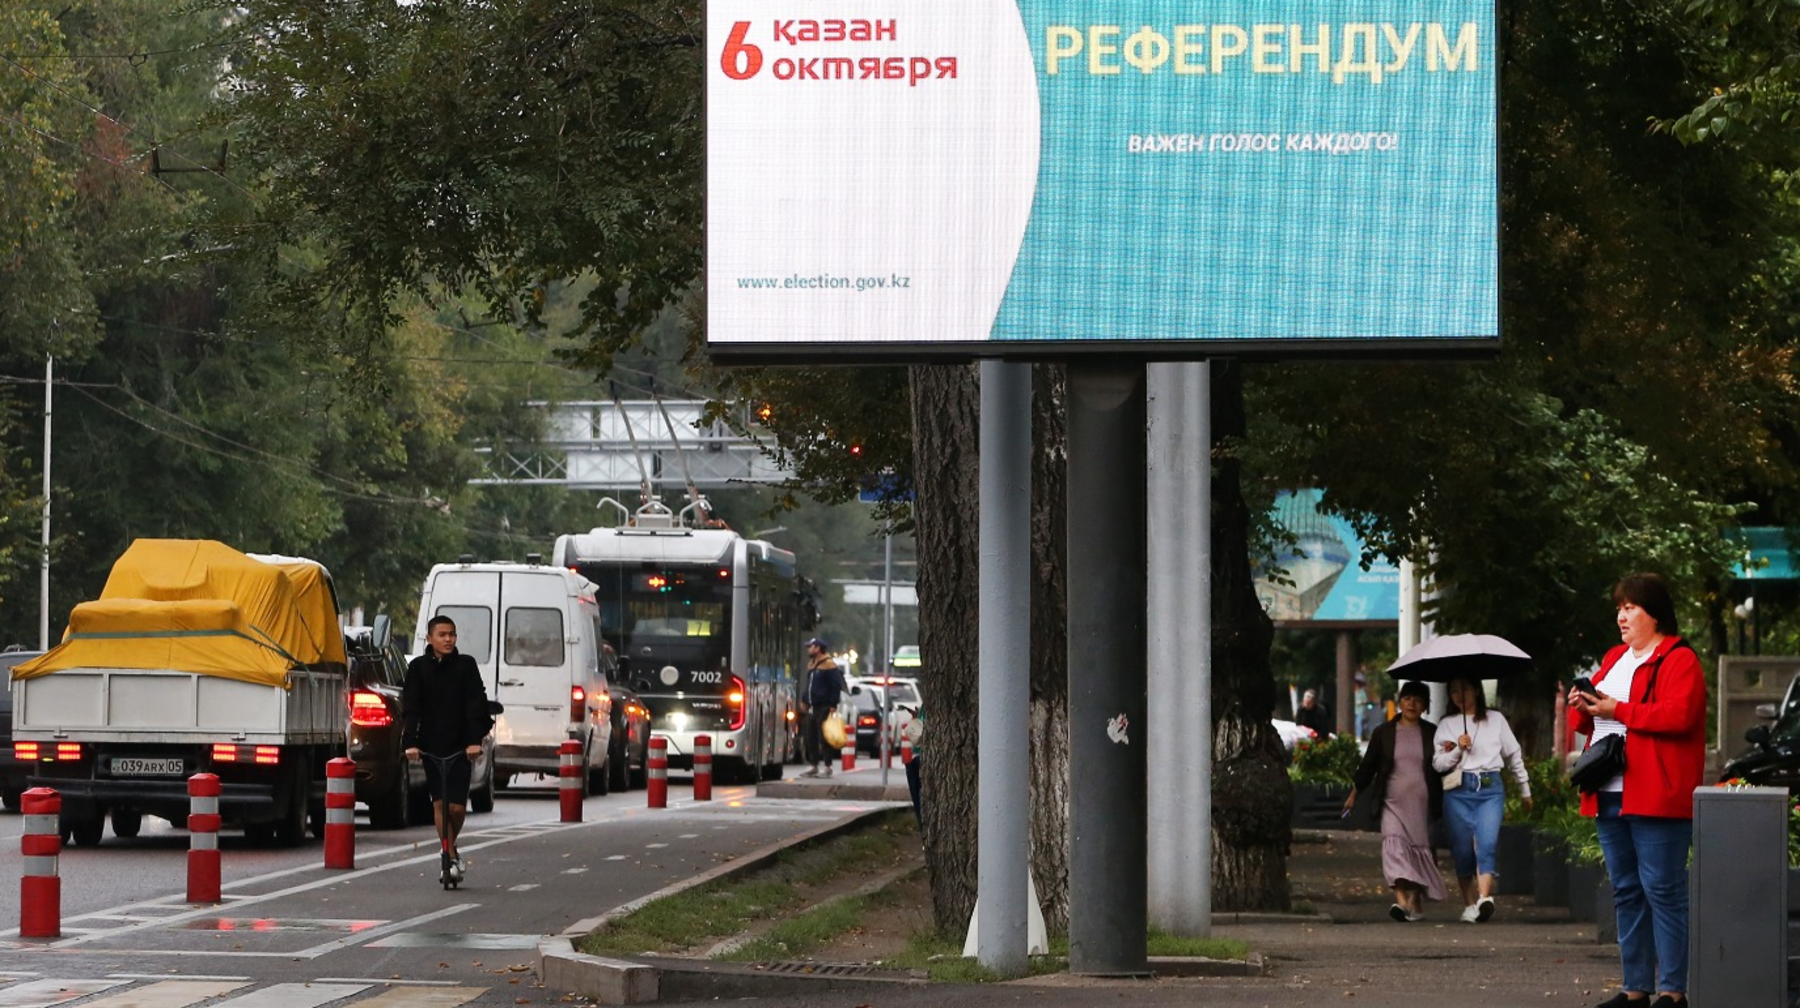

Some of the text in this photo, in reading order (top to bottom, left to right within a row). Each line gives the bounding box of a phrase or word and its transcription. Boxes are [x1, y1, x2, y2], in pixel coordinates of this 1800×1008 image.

[773, 18, 897, 46] қазан
[720, 20, 764, 80] 6
[1045, 22, 1479, 85] РЕФЕРЕНДУМ
[772, 56, 958, 87] октября
[1128, 131, 1399, 155] ВАЖЕН ГОЛОС КАЖДОГО!
[737, 272, 911, 292] www.election.gov.kz
[690, 670, 722, 684] 7002
[168, 760, 183, 773] 05
